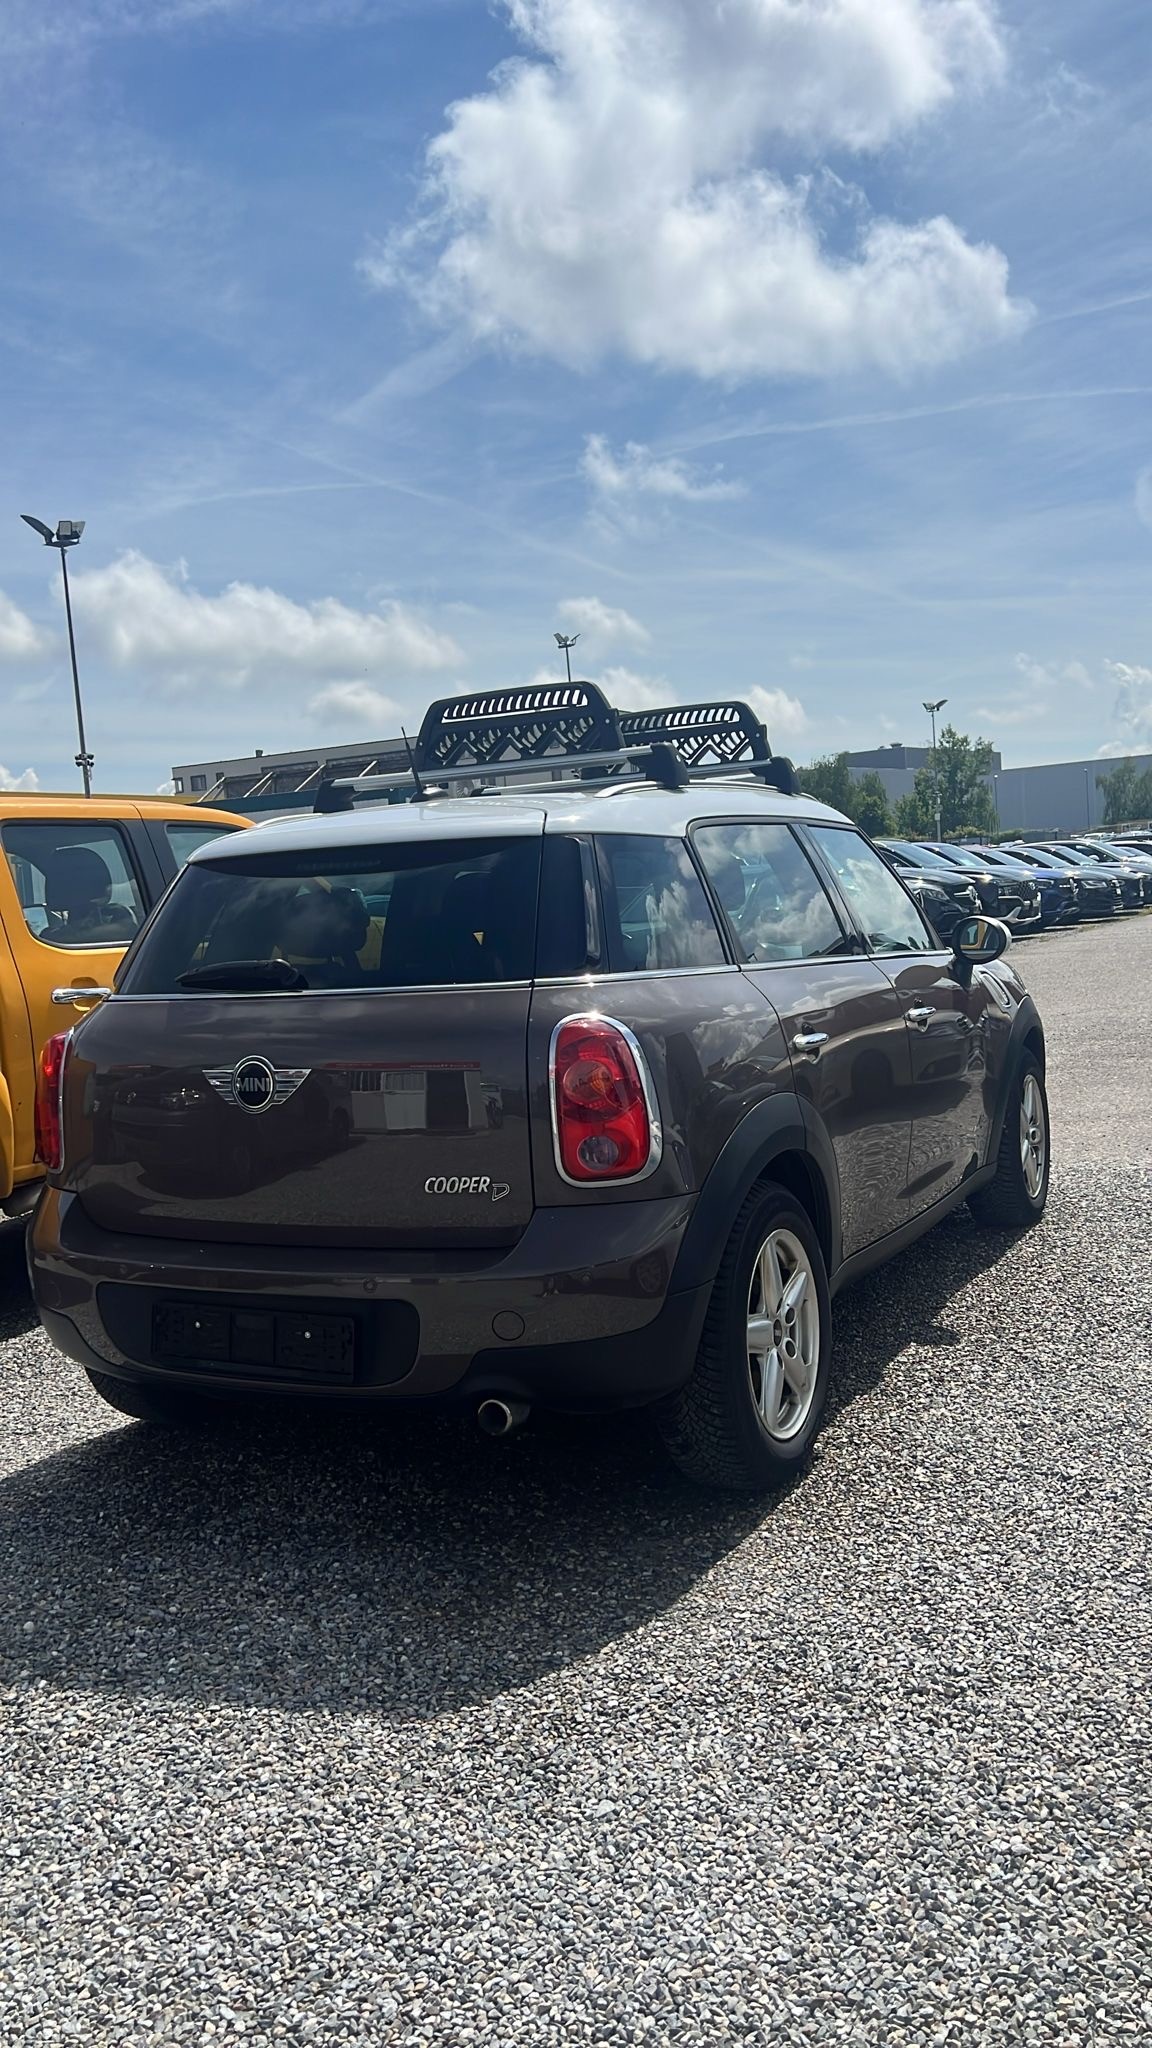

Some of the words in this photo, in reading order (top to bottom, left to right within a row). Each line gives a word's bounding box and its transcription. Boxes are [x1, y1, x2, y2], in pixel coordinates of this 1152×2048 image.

[237, 1077, 270, 1092] MINI
[424, 1176, 491, 1194] COOPER
[491, 1183, 510, 1202] D
